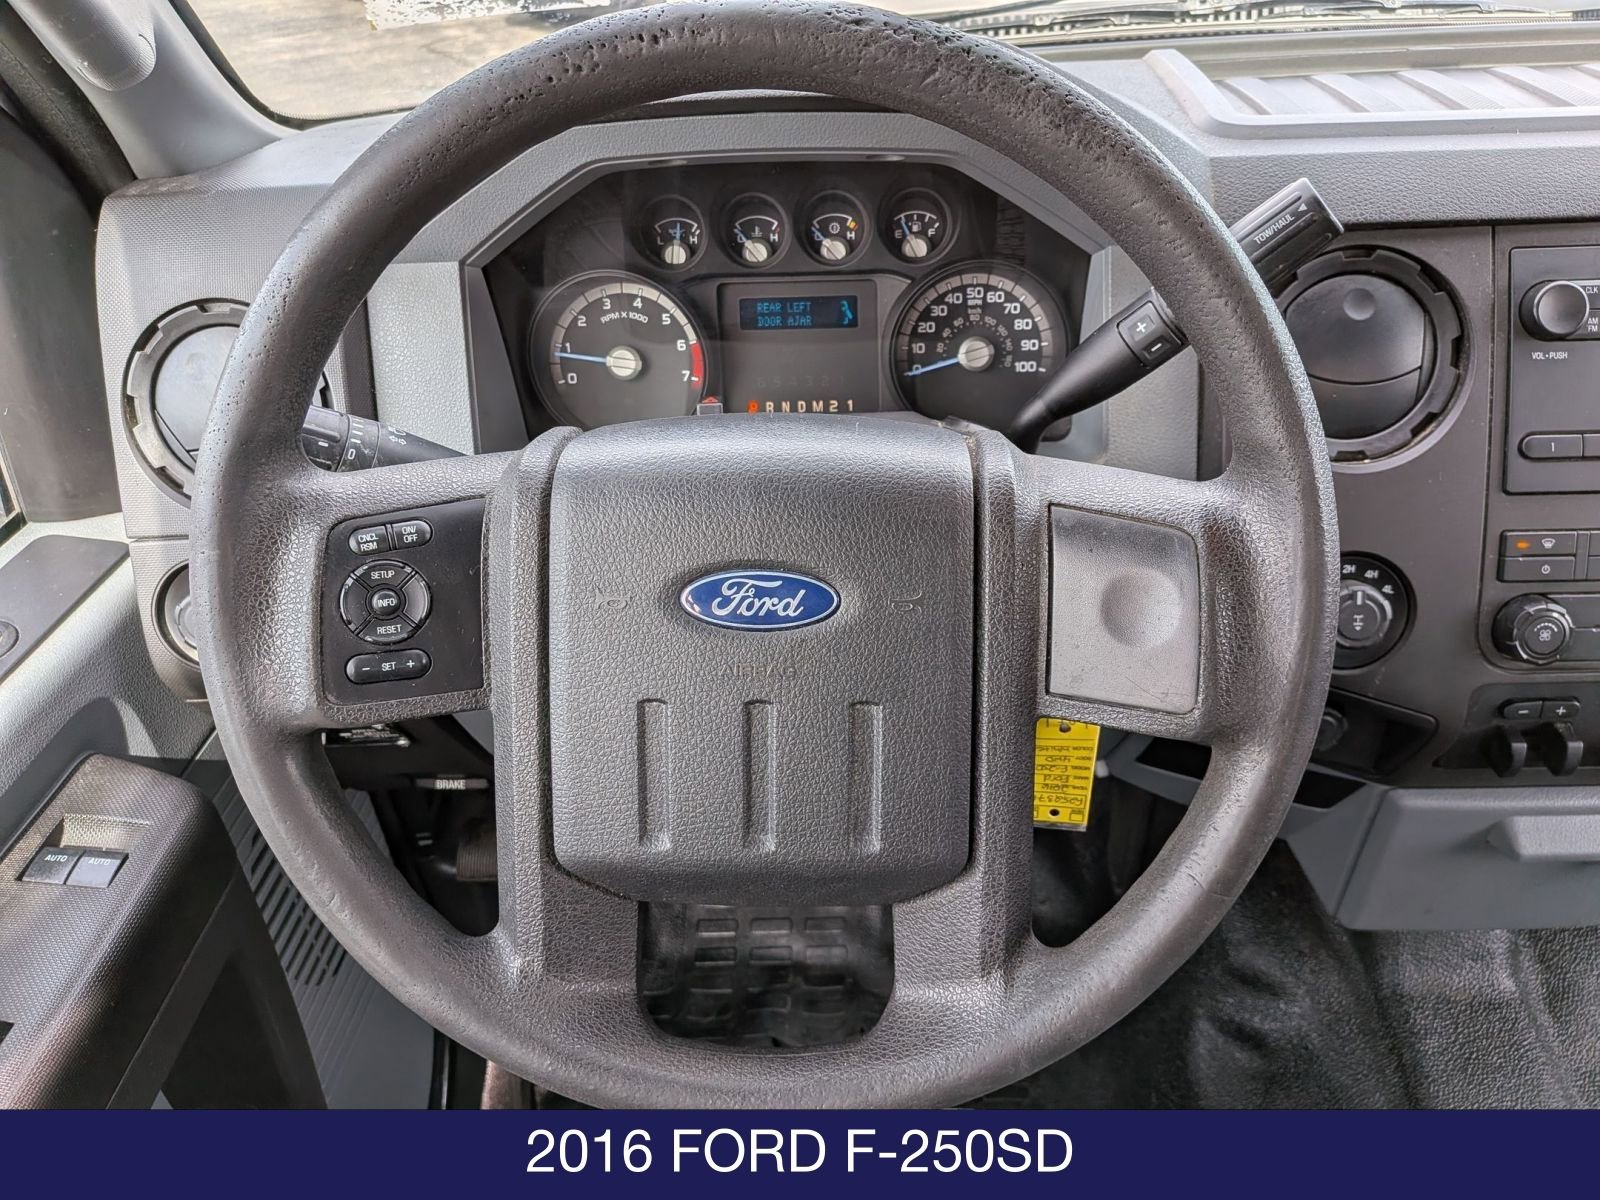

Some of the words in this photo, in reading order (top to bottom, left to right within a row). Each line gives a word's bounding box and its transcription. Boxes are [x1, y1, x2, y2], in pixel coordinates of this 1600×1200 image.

[895, 229, 903, 238] E
[928, 228, 936, 237] F
[1253, 213, 1295, 245] TOW/HAUL
[657, 236, 664, 245] L
[689, 235, 698, 244] H
[770, 233, 778, 242] H
[847, 231, 855, 240] H
[966, 287, 984, 298] 50
[986, 292, 1004, 303] 60
[633, 298, 642, 309] 4
[945, 293, 962, 304] 40
[602, 299, 611, 310] 3
[756, 302, 782, 313] REAR
[787, 302, 812, 313] LEFT
[1003, 303, 1020, 314] 70
[930, 305, 947, 316] 30
[577, 316, 587, 327] 2
[600, 312, 620, 324] RPM
[620, 311, 628, 319] X
[629, 311, 649, 324] 1000
[662, 313, 671, 325] 5
[757, 316, 782, 327] DOOR
[788, 316, 812, 326] AJAR
[1587, 317, 1599, 325] AM
[917, 322, 935, 333] 20
[1014, 319, 1032, 330] 80
[676, 340, 686, 351] 6
[912, 343, 925, 353] 10
[1021, 339, 1038, 350] 90
[1014, 361, 1037, 372] 100
[568, 373, 577, 384] 0
[682, 371, 690, 382] 7
[766, 402, 774, 413] R
[782, 402, 790, 413] N
[798, 401, 806, 412] D
[813, 400, 823, 412] M
[829, 401, 838, 412] 2
[358, 533, 379, 543] CNCL
[403, 534, 418, 543] OFF
[360, 542, 378, 551] RSM
[1342, 564, 1356, 574] 2H
[1364, 570, 1379, 579] 4H
[370, 570, 395, 580] SETUP
[1381, 584, 1395, 594] 4L
[377, 598, 396, 607] INFO
[711, 579, 806, 617] Ford
[377, 624, 402, 635] RESET
[381, 662, 396, 671] SET
[718, 662, 797, 680] AIRBAG
[435, 779, 466, 790] BRAKE
[45, 854, 68, 862] AUTO
[88, 858, 111, 866] AUTO
